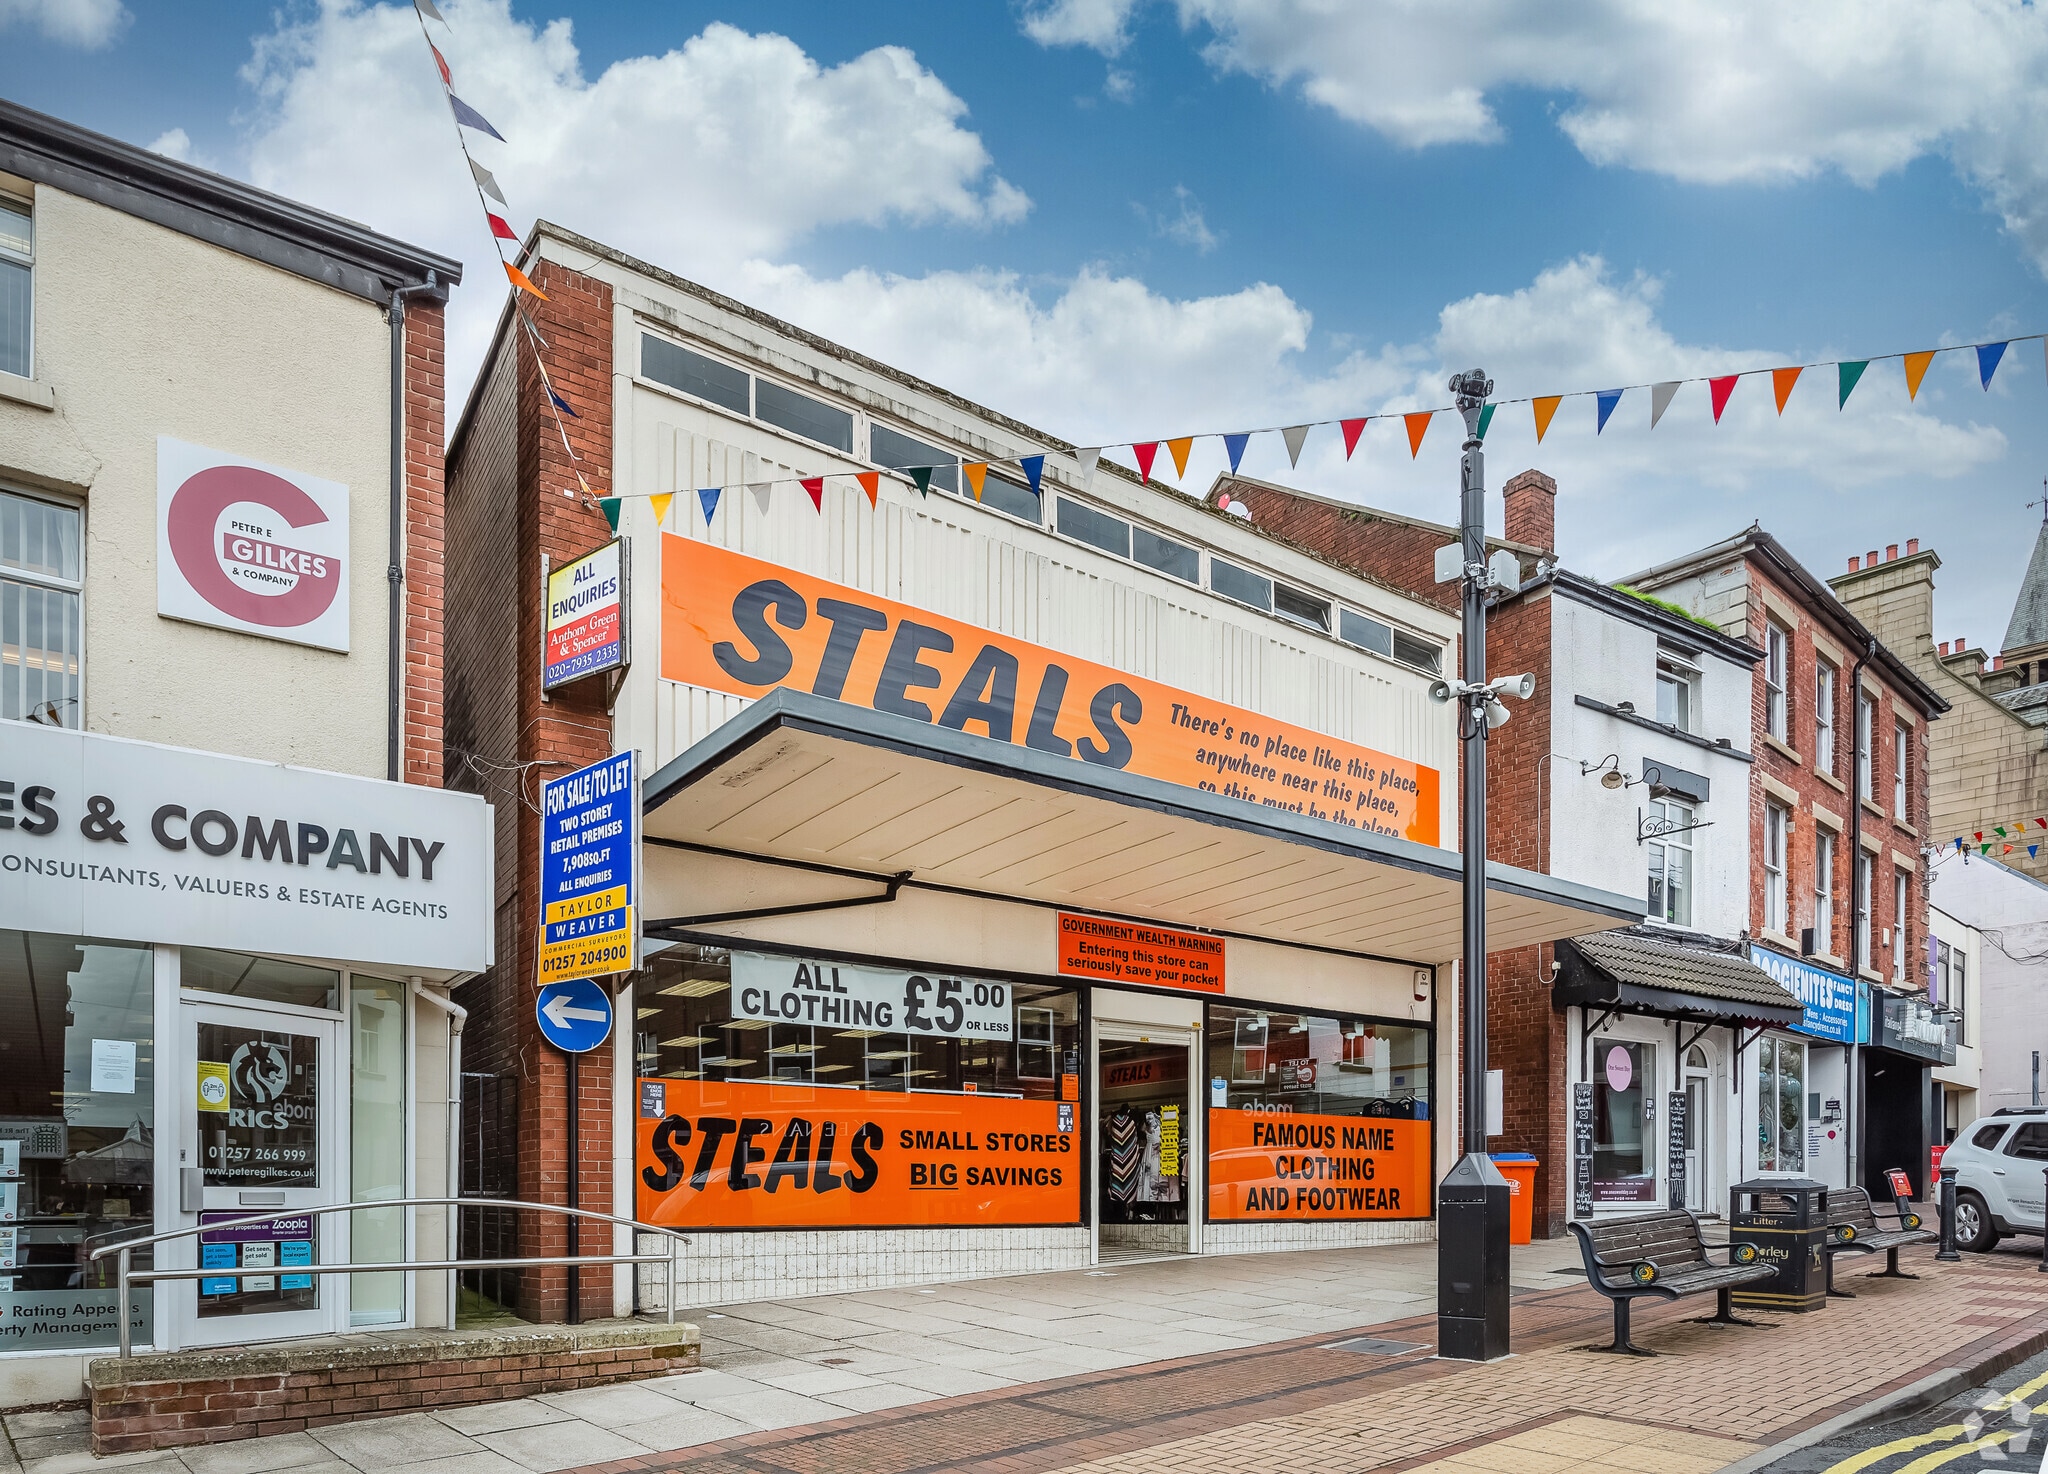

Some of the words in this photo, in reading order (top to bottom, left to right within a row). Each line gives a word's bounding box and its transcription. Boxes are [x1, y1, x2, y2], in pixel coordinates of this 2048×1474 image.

[232, 520, 263, 536] PETER
[266, 530, 272, 538] E
[232, 539, 327, 579] GILKES
[232, 567, 240, 576] &
[244, 570, 294, 587] COMPANY
[574, 562, 595, 586] ALL
[552, 576, 616, 619] ENQUIRIES
[550, 623, 587, 646] Anthony
[589, 612, 617, 632] Green
[560, 642, 569, 656] &
[572, 631, 607, 653] Spencer
[549, 653, 592, 679] 020-7935
[596, 643, 618, 663] 2335
[713, 579, 1143, 770] STEALS
[1171, 703, 1233, 741] There's
[1240, 730, 1260, 748] no
[1265, 735, 1306, 762] place
[1313, 746, 1340, 772] like
[1347, 758, 1376, 782] this
[1380, 769, 1420, 797] place,
[547, 784, 565, 816] FOR
[567, 767, 608, 809] SALE/TO
[610, 759, 629, 794] LET
[1196, 748, 1276, 782] anywhere
[1282, 771, 1318, 793] near
[1324, 779, 1352, 802] this
[1356, 789, 1399, 818] place,
[1224, 782, 1256, 802] this
[560, 815, 578, 833] TWO
[581, 803, 612, 826] STOREY
[80, 795, 129, 843] &
[151, 804, 445, 881] COMPANY
[551, 834, 580, 854] RETAIL
[582, 819, 622, 845] PREMISES
[2, 855, 167, 891] ONSULTANTS,
[174, 874, 269, 899] VALUERS
[277, 886, 291, 902] &
[300, 888, 365, 910] ESTATE
[371, 897, 448, 919] AGENTS
[559, 880, 573, 893] ALL
[575, 869, 612, 889] ENQUIRIES
[560, 895, 612, 917] TAYLOR
[556, 914, 615, 937] WEAVER
[1062, 918, 1134, 940] GOVERNMENT
[1136, 930, 1176, 946] WEALTH
[1178, 936, 1222, 953] WARNING
[545, 942, 586, 954] COMMERCIAL
[589, 933, 626, 946] SURVEYORS
[543, 954, 576, 972] 01257
[580, 945, 626, 965] 204900
[1079, 942, 1129, 962] Entering
[1132, 950, 1154, 963] this
[1157, 954, 1186, 967] store
[1189, 960, 1208, 970] can
[793, 963, 848, 994] ALL
[1067, 955, 1122, 975] seriously
[1125, 964, 1152, 977] save
[1155, 969, 1179, 981] your
[1182, 972, 1219, 986] pocket
[1833, 981, 1853, 995] FANCY
[741, 988, 893, 1027] CLOTHING
[1834, 998, 1853, 1012] DRESS
[966, 1020, 981, 1030] OR
[984, 1021, 1009, 1032] LESS
[1822, 1012, 1848, 1026] Accessories
[1109, 1064, 1151, 1084] STEALS
[229, 1108, 289, 1130] RICS
[900, 1130, 978, 1150] SMALL
[986, 1133, 1071, 1153] STORES
[1253, 1122, 1335, 1149] FAMOUS
[1343, 1127, 1394, 1150] NAME
[209, 1146, 250, 1159] 01257
[255, 1149, 279, 1160] 266
[284, 1149, 306, 1160] 999
[641, 1114, 884, 1194] STEALS
[203, 1167, 315, 1178] www.peteregilkes.co.uk
[910, 1163, 958, 1186] BIG
[966, 1167, 1062, 1186] SAVINGS
[1276, 1156, 1375, 1181] CLOTHING
[1246, 1187, 1289, 1211] AND
[1296, 1188, 1400, 1211] FOOTWEAR
[272, 1218, 307, 1230] Zoopla
[1759, 1246, 1788, 1259] orley
[13, 1304, 66, 1318] Rating
[72, 1303, 139, 1317] Appes
[32, 1320, 143, 1335] Managemnt
